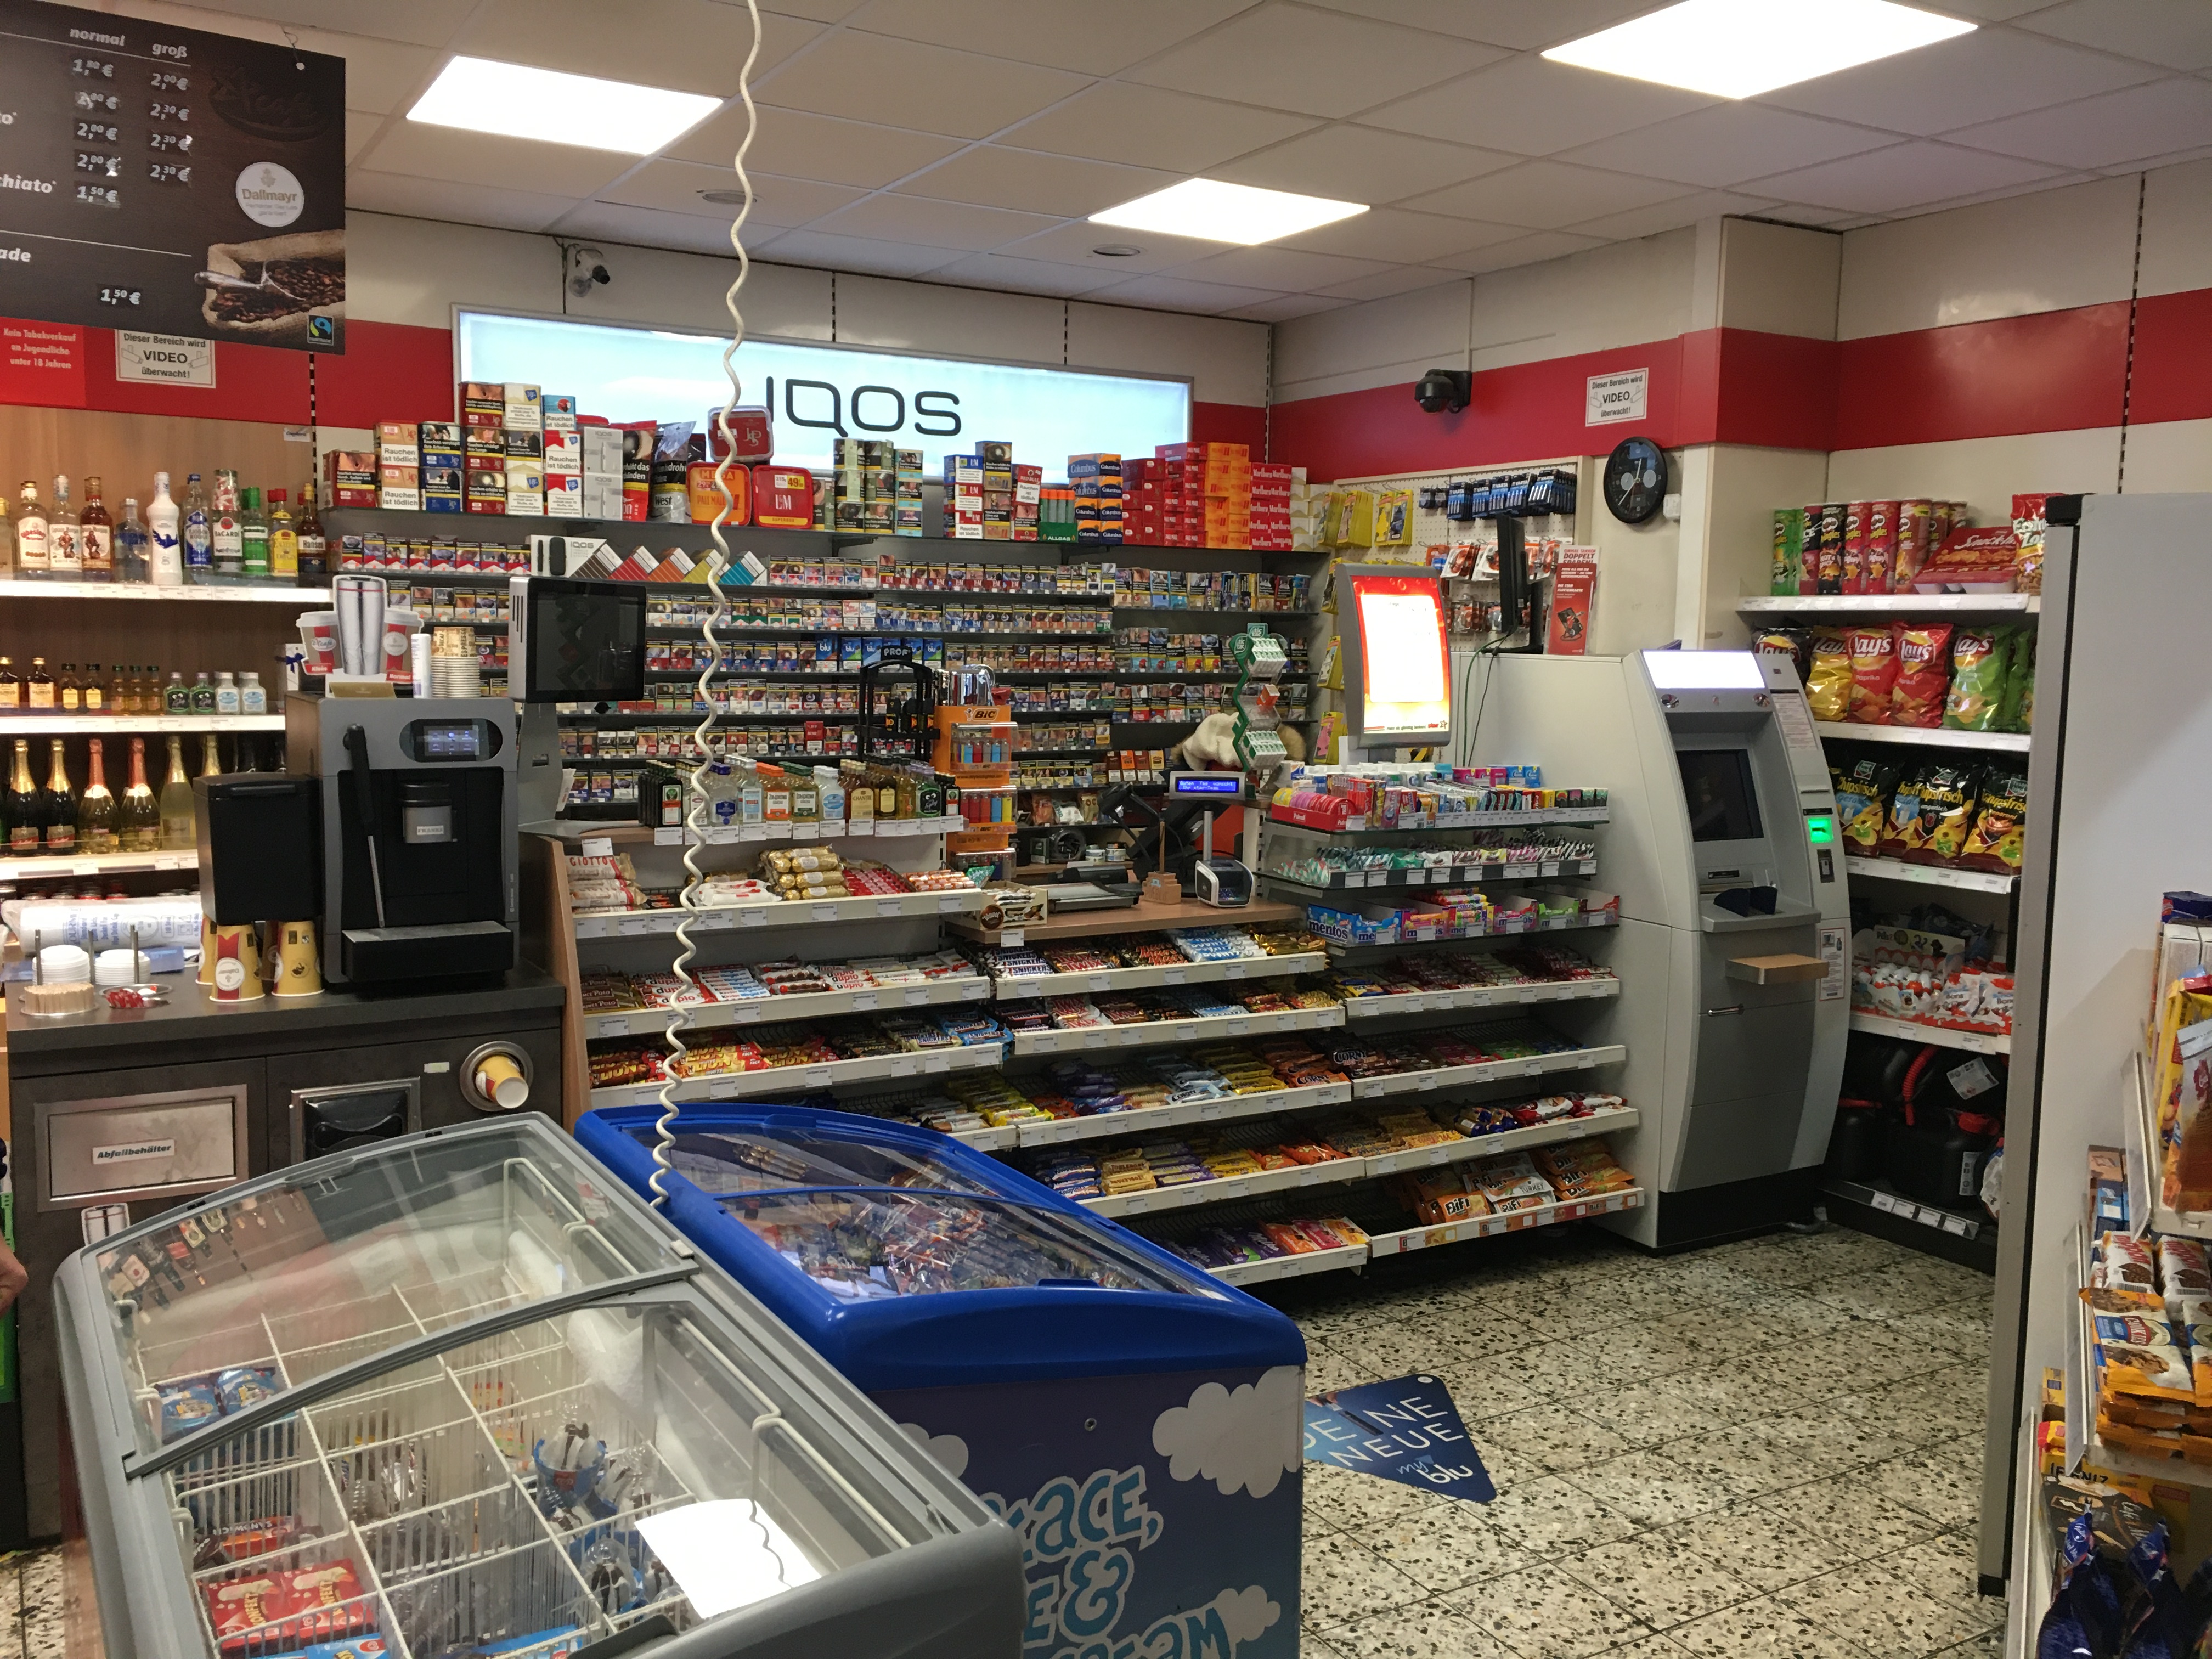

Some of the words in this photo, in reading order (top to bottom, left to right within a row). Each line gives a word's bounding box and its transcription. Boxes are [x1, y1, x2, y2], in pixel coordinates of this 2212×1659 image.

[70, 29, 126, 46] normal
[152, 43, 187, 59] groß
[241, 188, 298, 203] Dallmayr
[123, 332, 150, 343] Dieser
[153, 335, 185, 346] Bereich
[188, 339, 206, 348] wird
[143, 350, 188, 364] VIDEO
[142, 366, 190, 379] überwacht!
[1592, 381, 1608, 390] Dieser
[1609, 377, 1629, 387] Bereich
[1630, 375, 1643, 383] wird
[1602, 391, 1630, 404] VIDEO
[766, 376, 962, 438] IQOS
[1600, 406, 1631, 417] überwacht!
[1070, 464, 1096, 473] Columbus
[655, 496, 673, 505] West
[819, 641, 831, 651] blu
[845, 644, 854, 652] blu
[867, 644, 875, 652] blu
[1854, 635, 1894, 657] Lay's
[1901, 640, 1931, 662] Lay's
[1955, 636, 1993, 656] Lay's
[974, 710, 997, 719] BIC
[569, 856, 608, 866] GIOTTO
[1308, 920, 1349, 940] mentos
[1013, 964, 1052, 974] SNICKERS
[1060, 961, 1104, 972] TWIX
[662, 995, 695, 1003] dplo
[1334, 1049, 1367, 1064] CORNY
[695, 1058, 732, 1071] LION
[601, 1065, 637, 1080] LION
[1296, 1074, 1329, 1085] CORNY
[1171, 1089, 1197, 1102] CORNY
[97, 1146, 171, 1159] Abfallbehälter
[1520, 1182, 1545, 1194] TURKEY
[2124, 1317, 2147, 1344] COOKIES
[1327, 1423, 1464, 1467] NEUE
[1396, 1460, 1429, 1474] my
[1415, 1464, 1474, 1483] blu
